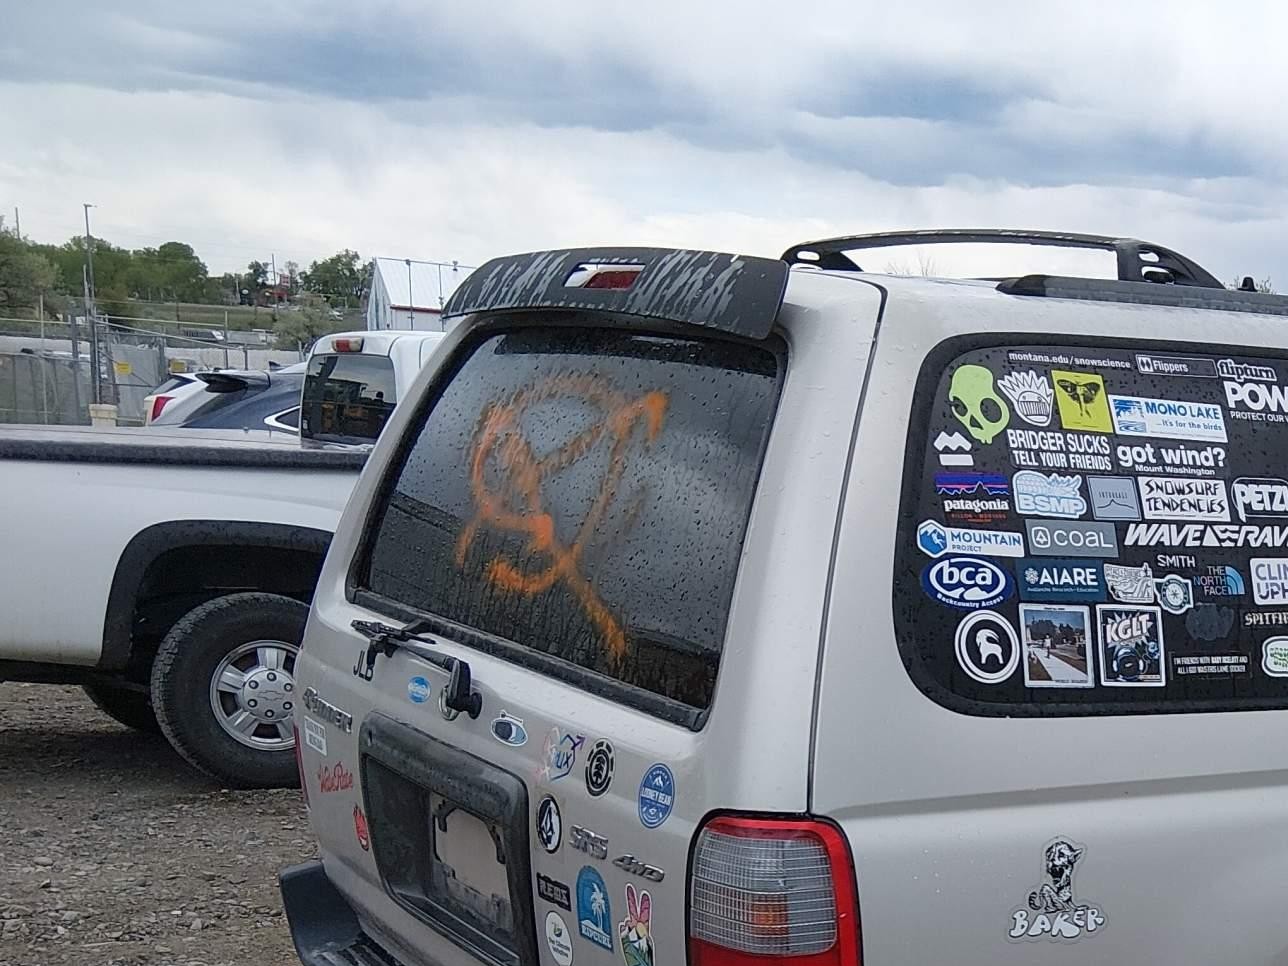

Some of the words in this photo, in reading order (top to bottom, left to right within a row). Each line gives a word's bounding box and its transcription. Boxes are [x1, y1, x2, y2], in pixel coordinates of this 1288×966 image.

[1153, 360, 1189, 373] Flippers
[1219, 360, 1276, 380] flipturn
[1144, 401, 1188, 416] MONO
[1189, 405, 1221, 420] LAKE
[1229, 410, 1266, 421] PROTECT
[1267, 413, 1285, 422] OUR
[1007, 429, 1064, 451] BRIDGER
[1067, 434, 1110, 455] SUCKS
[1012, 450, 1039, 467] TELL
[1040, 452, 1068, 468] YOUR
[1070, 454, 1112, 471] FRIENDS
[1117, 443, 1157, 467] got
[1160, 445, 1226, 467] wind?
[1135, 464, 1164, 473] Mount
[1165, 465, 1216, 476] Washington
[1145, 479, 1220, 496] SNOWSURF
[944, 498, 1009, 513] patagonia
[1018, 493, 1085, 515] BSMP
[1145, 496, 1226, 514] TENDENCIES
[950, 531, 1022, 546] MOUNTAIN
[951, 544, 982, 553] PROJECT
[1157, 554, 1196, 568] SMITH
[943, 559, 993, 585] bca
[1039, 567, 1099, 586] AIARE
[1206, 566, 1226, 576] THE
[1193, 575, 1227, 586] NORTH
[1204, 586, 1228, 596] FACE
[936, 592, 980, 609] Backcountry
[981, 595, 1004, 607] Access
[1105, 613, 1150, 644] KGLT
[1009, 907, 1105, 938] BAKER
